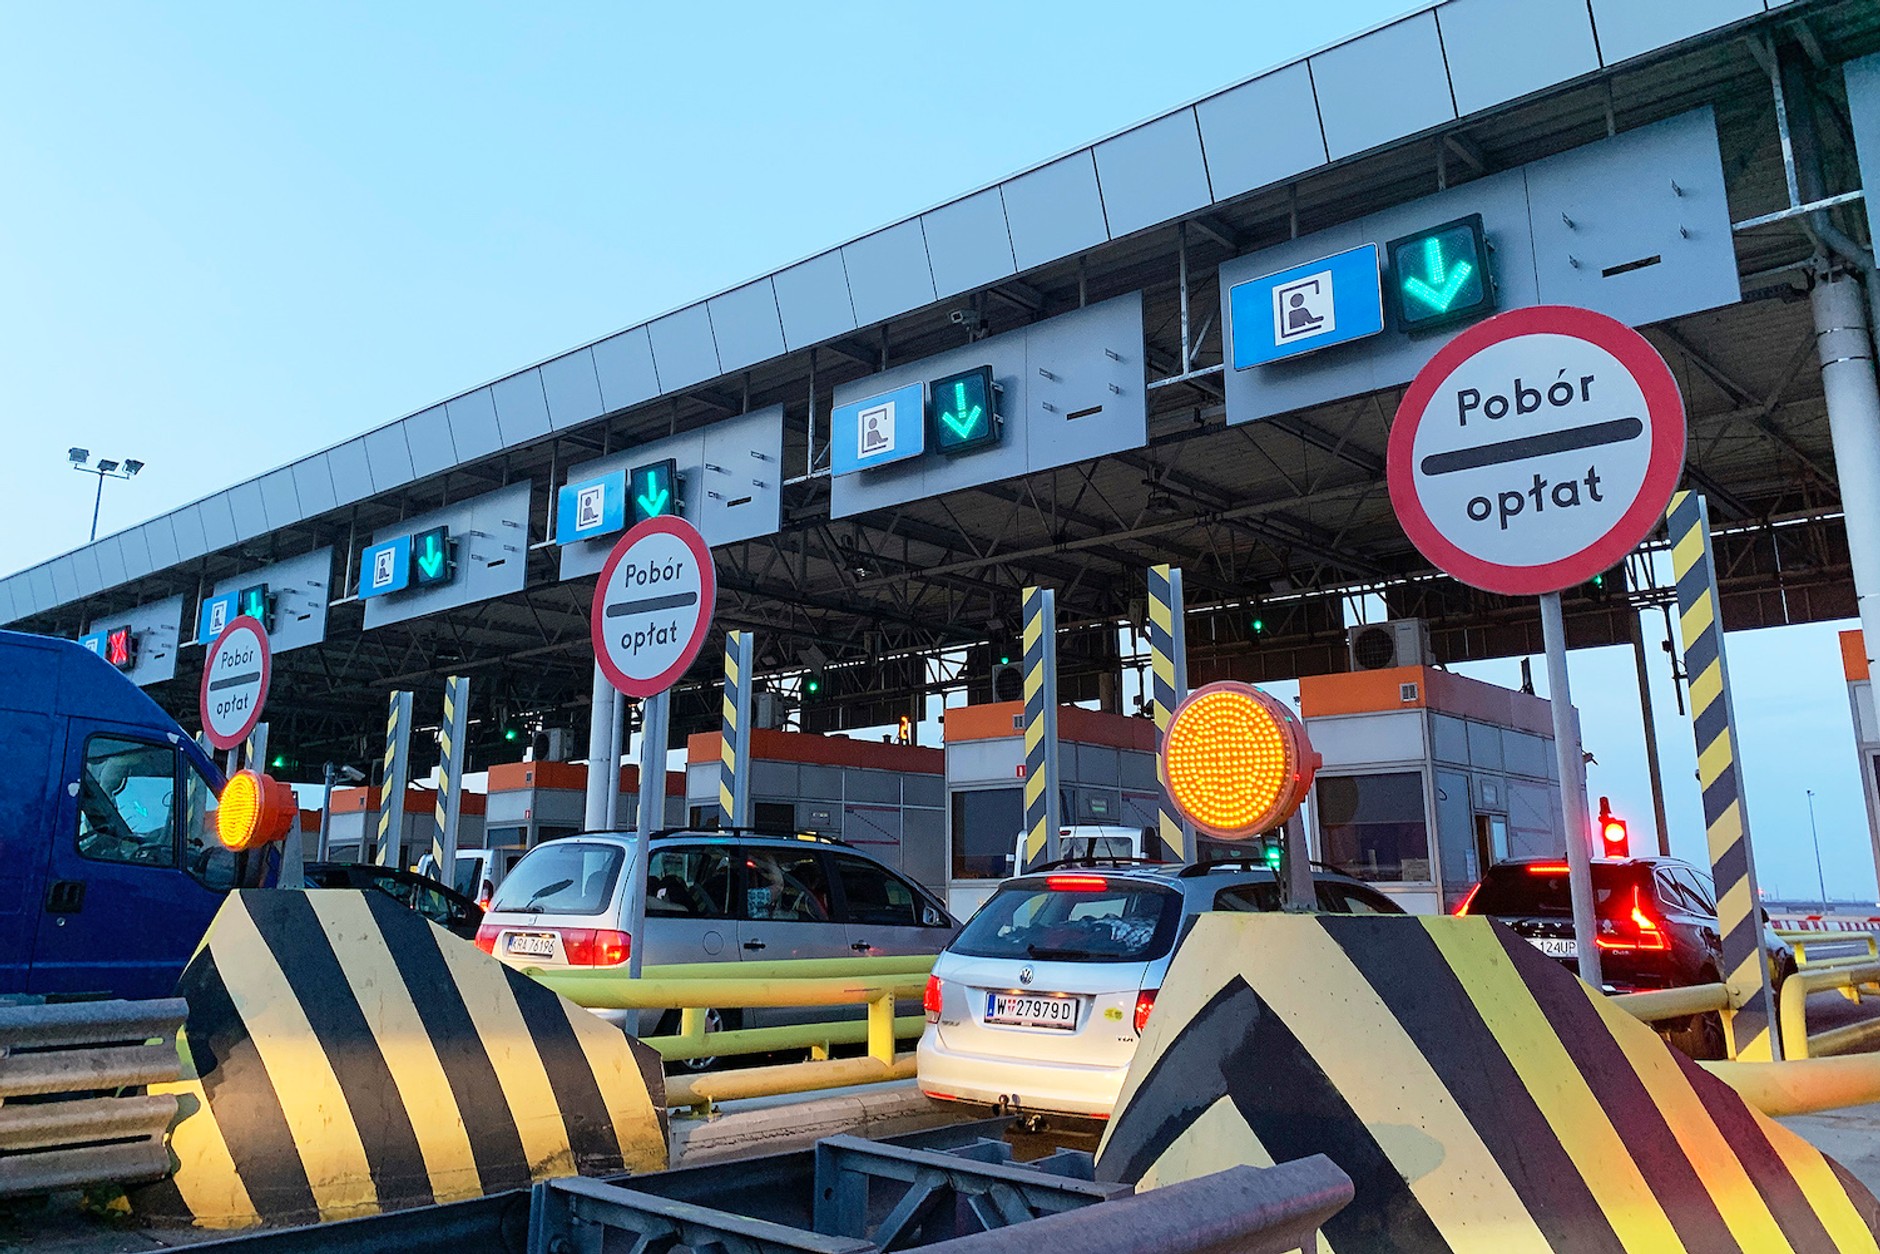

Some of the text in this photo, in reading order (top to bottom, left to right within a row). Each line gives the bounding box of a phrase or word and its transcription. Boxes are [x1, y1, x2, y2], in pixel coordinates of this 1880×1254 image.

[1457, 368, 1595, 427] Pobór
[1466, 465, 1604, 531] opłat
[625, 556, 684, 589] Pobór
[620, 620, 678, 656] opłat
[220, 645, 254, 670] Pobór
[216, 692, 250, 720] opłat
[1015, 999, 1059, 1019] 27979
[1062, 1002, 1071, 1020] D
